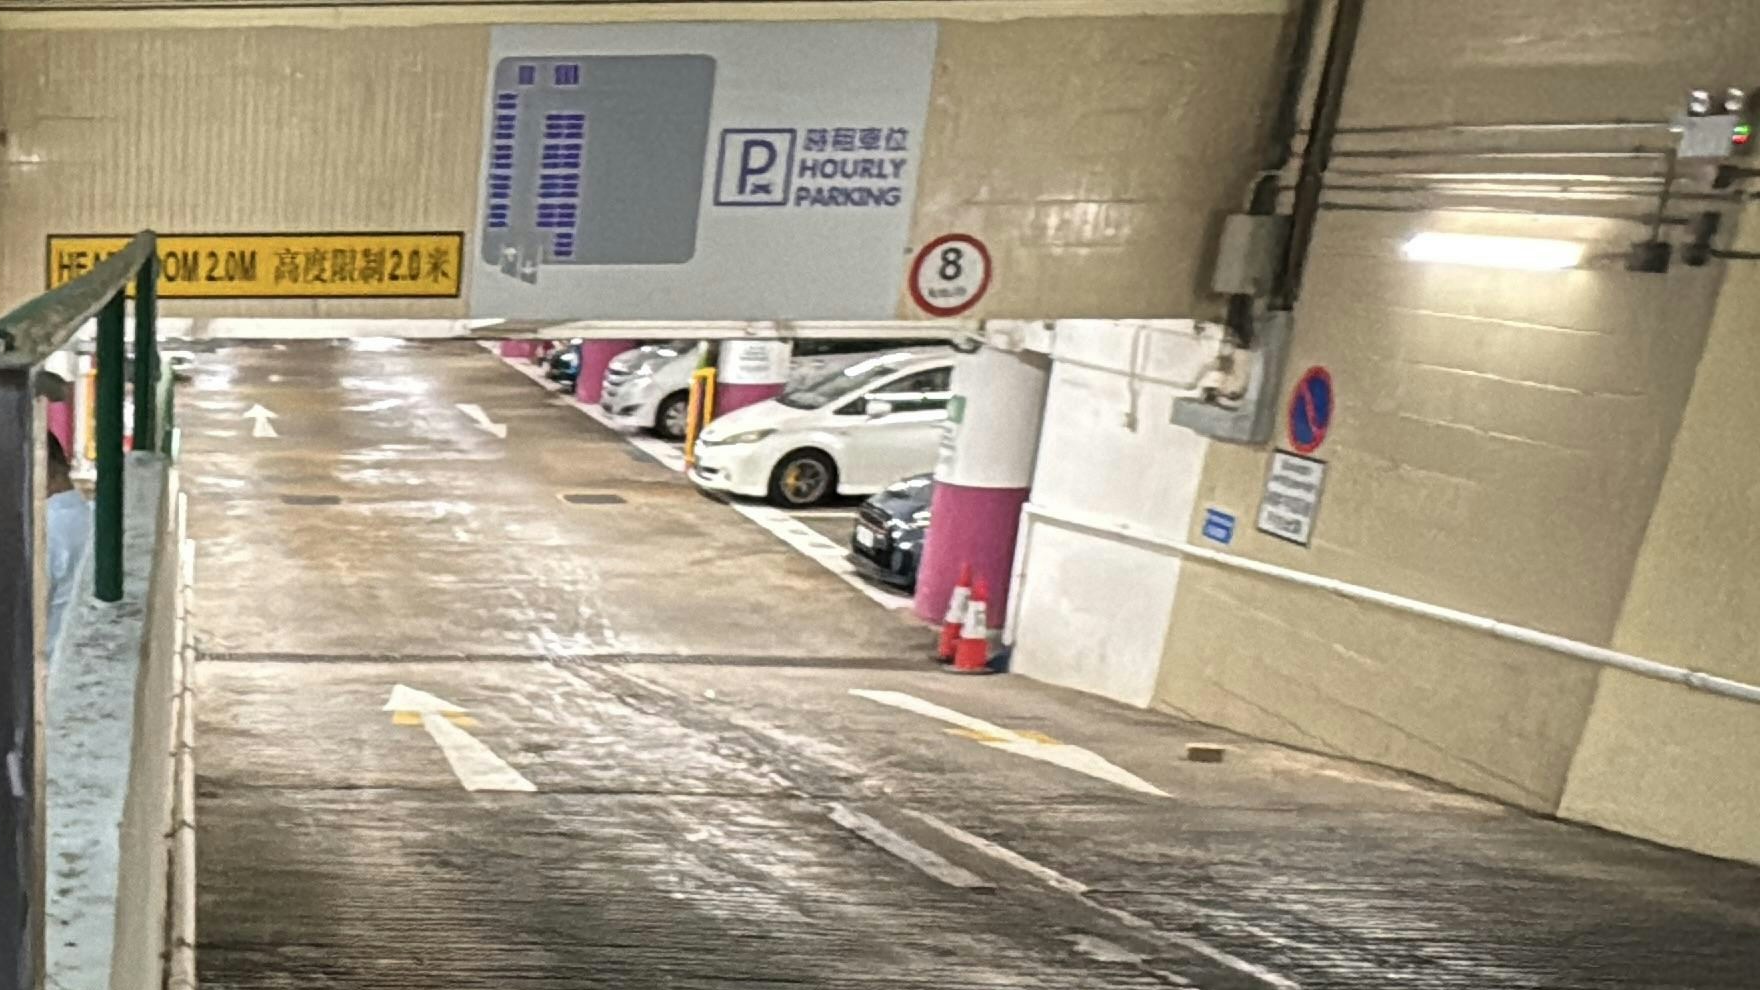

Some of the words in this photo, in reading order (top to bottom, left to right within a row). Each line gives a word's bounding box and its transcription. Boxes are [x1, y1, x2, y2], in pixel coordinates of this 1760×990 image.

[738, 140, 777, 195] P
[798, 158, 906, 178] HOURLY
[794, 186, 901, 206] PARKING
[205, 250, 256, 282] 2.0M
[939, 247, 962, 281] 8
